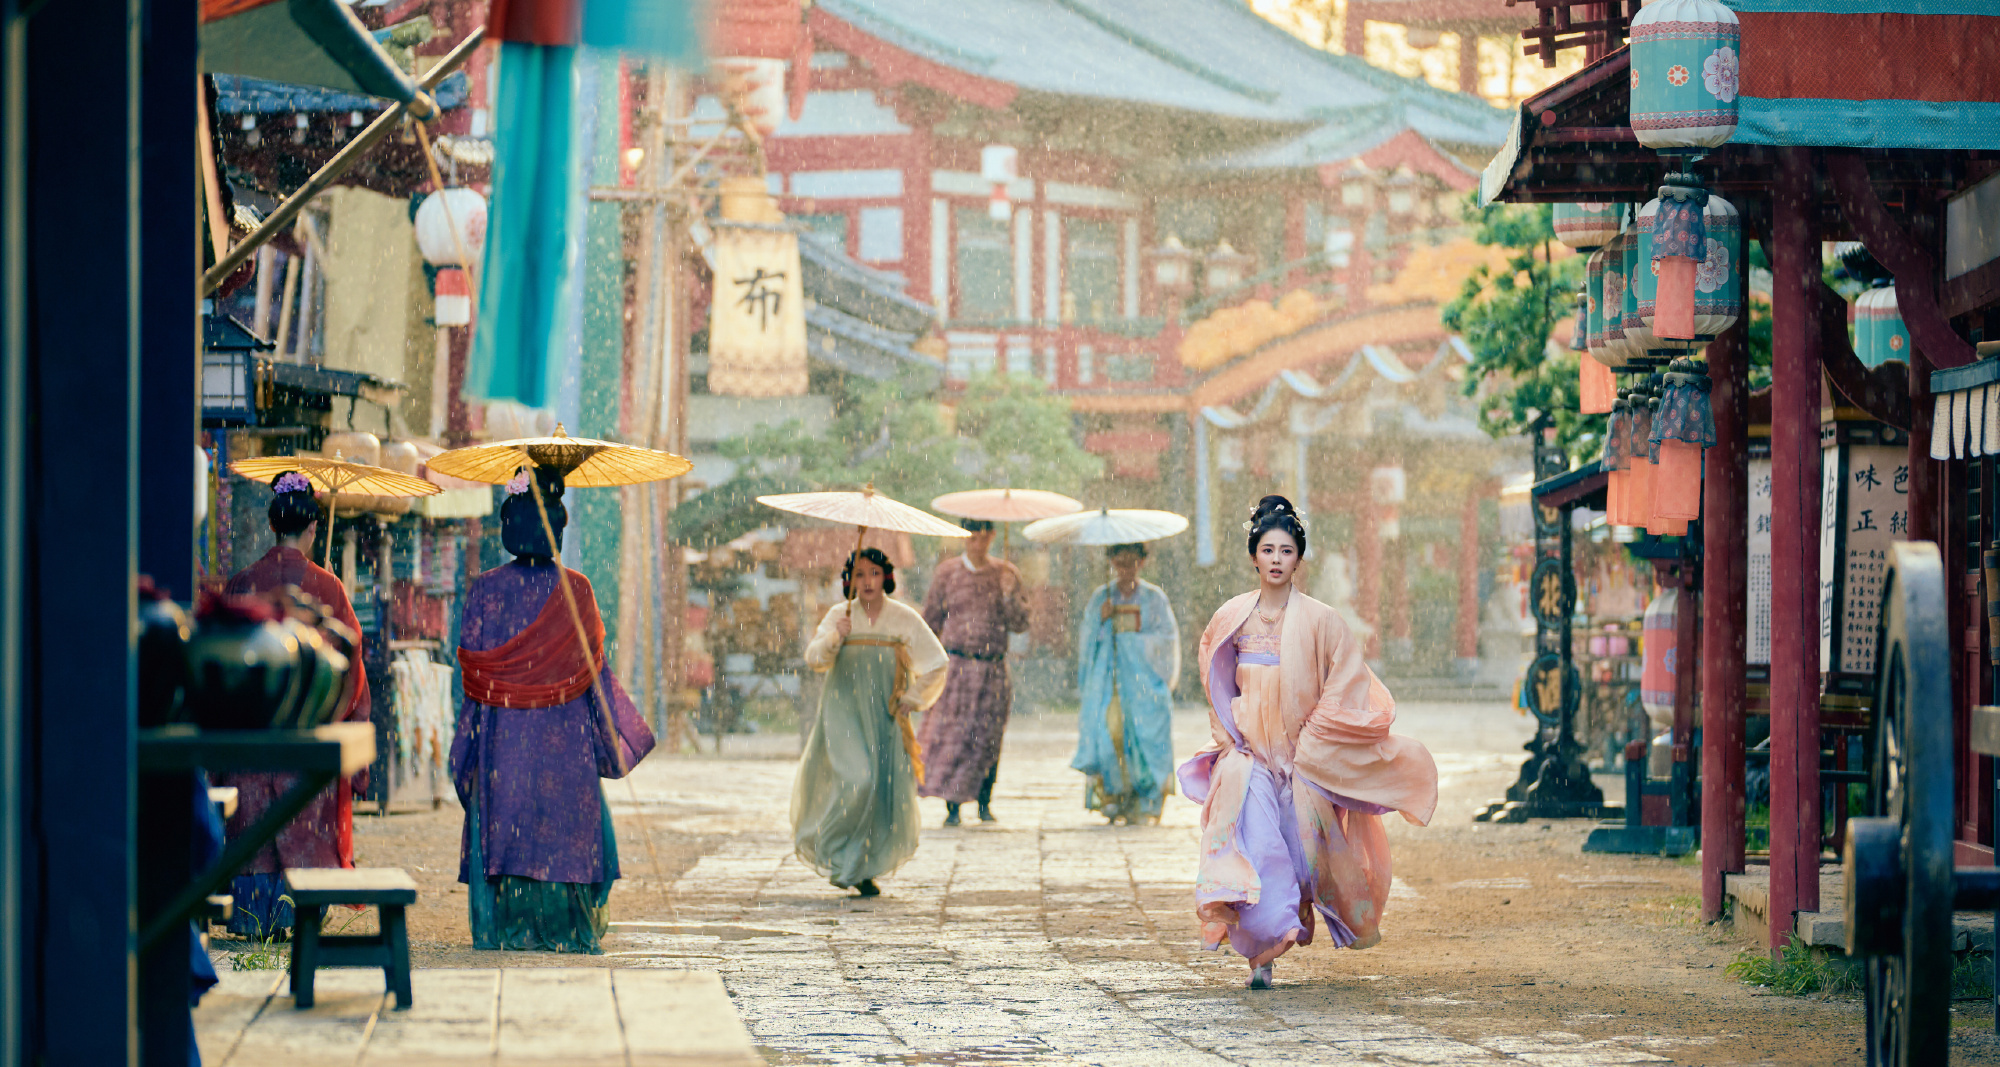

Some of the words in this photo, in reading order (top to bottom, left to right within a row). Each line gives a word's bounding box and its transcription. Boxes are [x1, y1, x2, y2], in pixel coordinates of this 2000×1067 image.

[734, 269, 784, 331] 布
[1852, 464, 1881, 532] 味正
[1889, 465, 1908, 534] 色純
